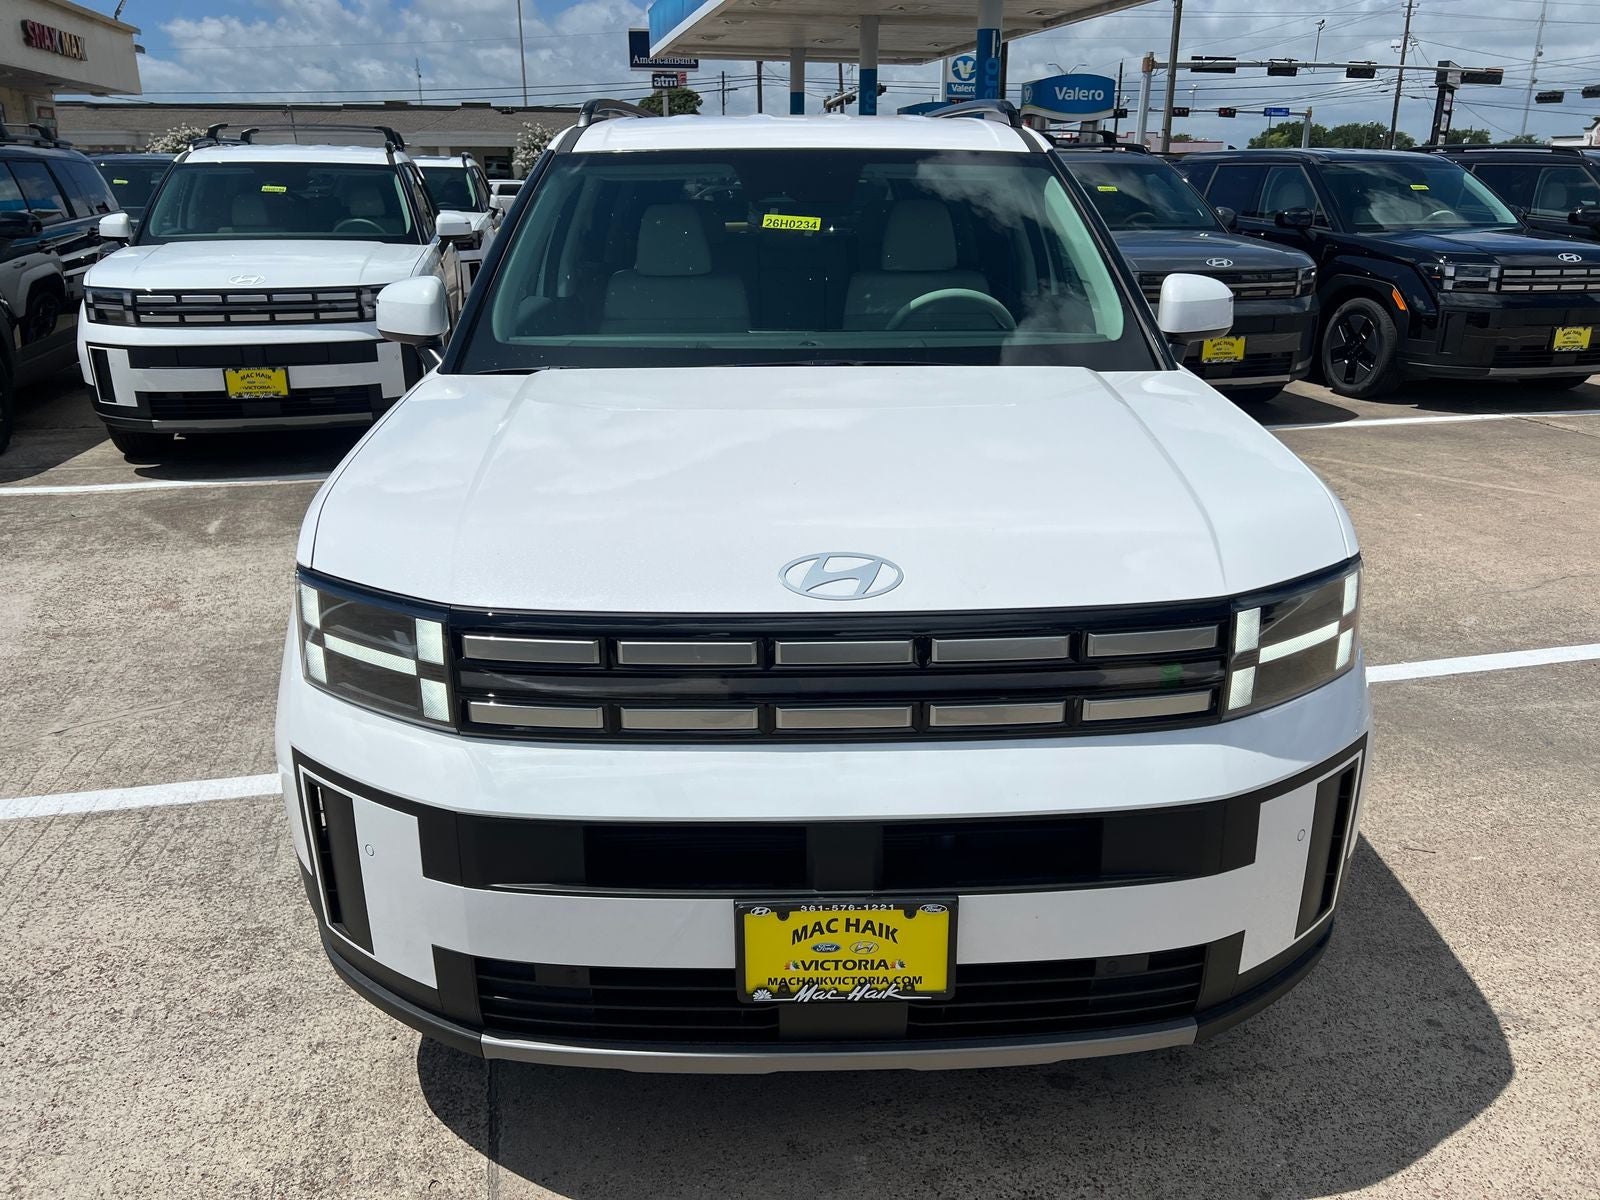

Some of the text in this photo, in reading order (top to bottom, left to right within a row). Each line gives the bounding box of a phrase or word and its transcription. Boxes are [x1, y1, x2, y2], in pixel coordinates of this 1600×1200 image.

[62, 30, 88, 61] MAX
[633, 55, 696, 65] AmericanBank
[654, 76, 677, 87] atm
[1054, 87, 1104, 101] Valero
[765, 218, 817, 229] 26H0234
[241, 372, 254, 381] MAC
[801, 904, 894, 912] 361-576-1221
[792, 918, 898, 946] MAC HAIK
[800, 959, 889, 971] VICTORIA
[767, 976, 923, 986] MACHAIKVICTORIA.COM
[793, 983, 914, 1002] Mac Haik
